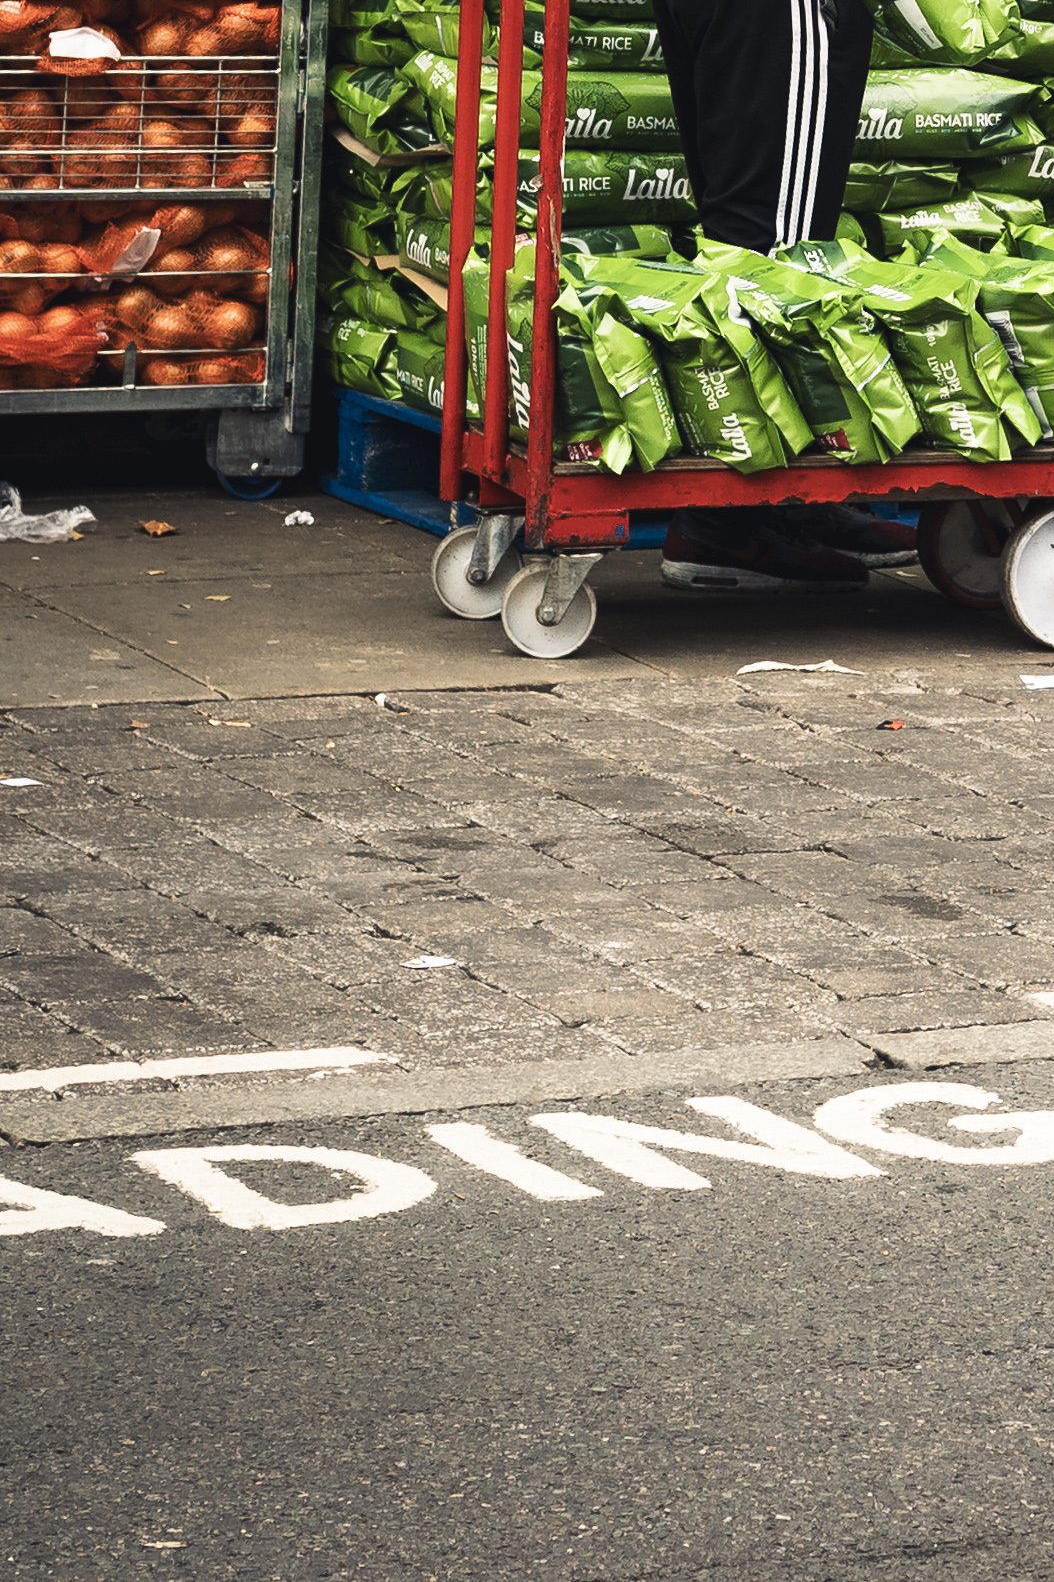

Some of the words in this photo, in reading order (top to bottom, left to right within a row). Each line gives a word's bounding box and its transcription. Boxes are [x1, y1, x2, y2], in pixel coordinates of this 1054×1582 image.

[601, 36, 633, 52] RICE
[564, 107, 613, 140] aila
[856, 107, 904, 140] aila
[915, 113, 973, 128] BASMATI
[578, 176, 611, 191] RICE
[622, 168, 692, 201] Laila
[405, 228, 432, 269] Laila
[939, 359, 963, 393] RICE
